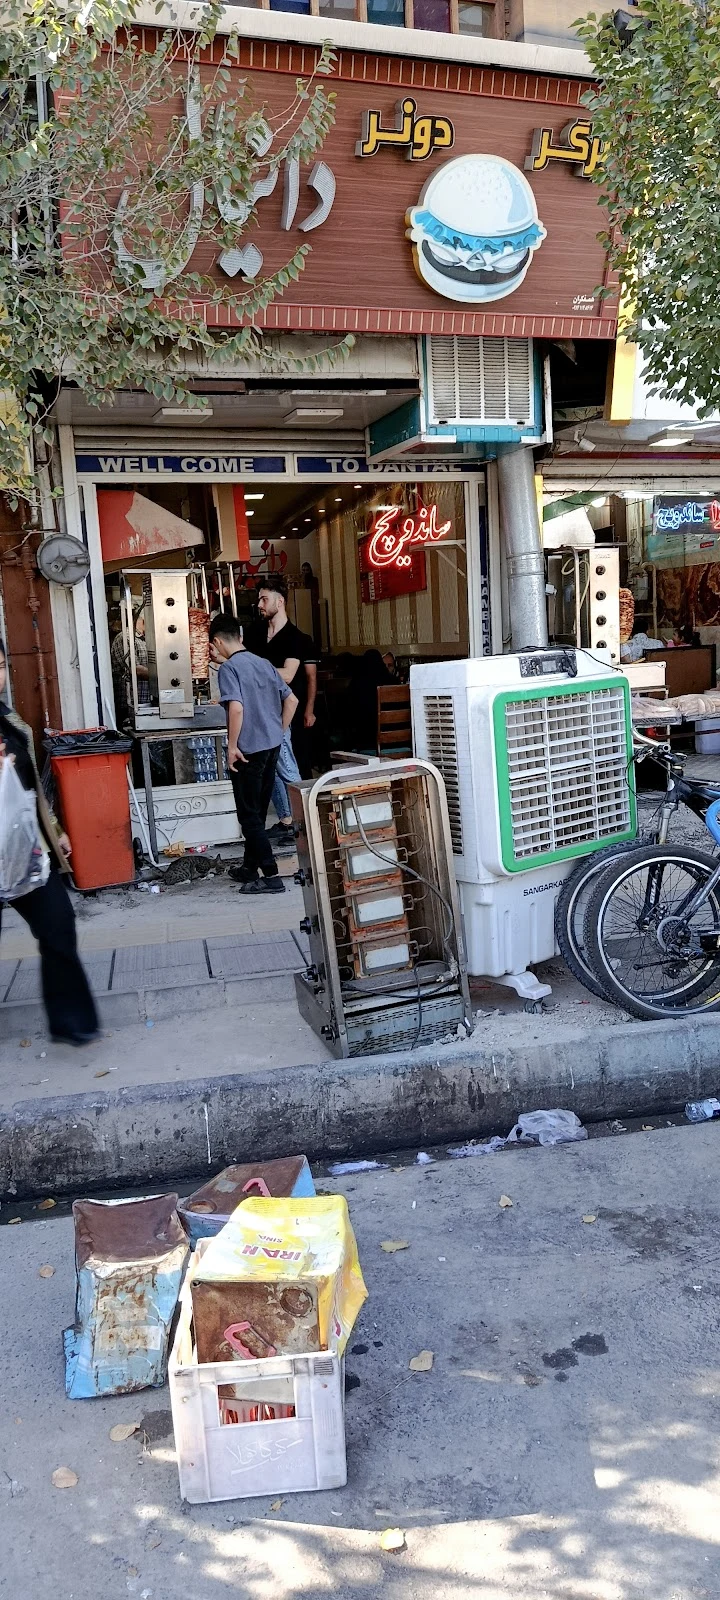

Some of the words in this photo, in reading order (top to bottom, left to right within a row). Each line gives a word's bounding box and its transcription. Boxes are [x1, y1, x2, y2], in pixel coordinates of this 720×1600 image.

[356, 97, 455, 161] دونر
[98, 458, 172, 472] WELL
[181, 458, 254, 472] COME
[326, 458, 359, 472] TO
[369, 505, 451, 566] ساندویچ
[241, 1244, 302, 1261] IRAN
